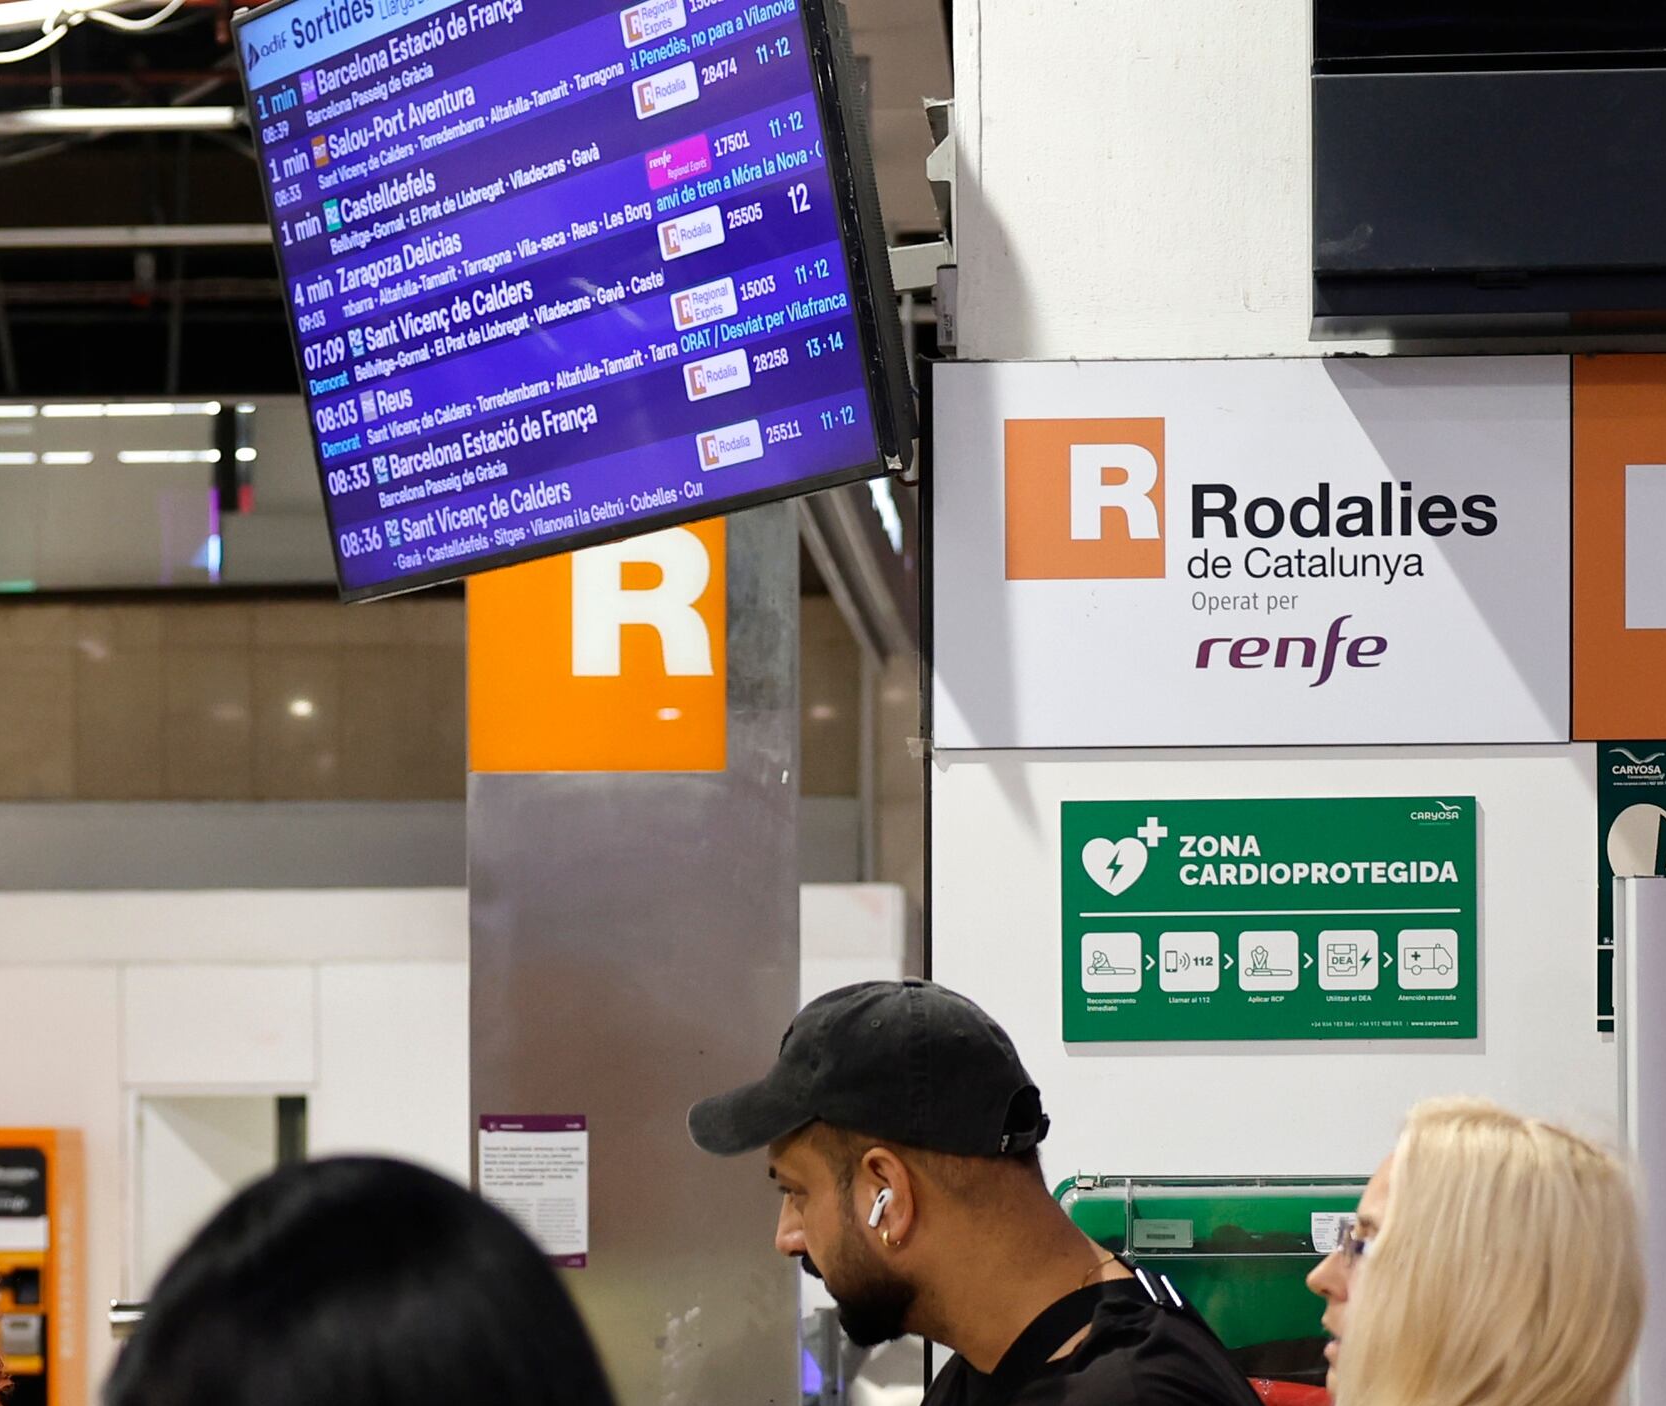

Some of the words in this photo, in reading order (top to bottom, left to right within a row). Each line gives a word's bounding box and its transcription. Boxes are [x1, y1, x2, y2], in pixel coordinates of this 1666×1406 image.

[291, 0, 374, 49] Sortides
[639, 36, 690, 68] Penedès,
[691, 31, 706, 48] no
[707, 20, 734, 46] para
[743, 0, 796, 27] Vilanova
[316, 49, 389, 95] Barcelona
[388, 17, 445, 65] Estació
[447, 12, 467, 40] de
[468, 0, 523, 32] França
[701, 57, 737, 85] 28474
[270, 84, 298, 114] min
[306, 98, 353, 127] Barcelona
[351, 81, 388, 108] Passeig
[388, 75, 402, 93] de
[401, 62, 434, 87] Gràcia
[328, 108, 407, 159] Salou-Port
[409, 86, 475, 129] Aventura
[714, 130, 750, 157] 17501
[269, 158, 281, 183] 1
[282, 148, 310, 178] min
[681, 184, 696, 204] de
[697, 179, 722, 198] tren
[731, 163, 763, 187] Móra
[762, 157, 776, 176] la
[776, 149, 808, 172] Nova
[324, 203, 341, 227] R2
[341, 168, 436, 223] Castelldefels
[787, 183, 811, 214] 12
[281, 221, 293, 246] 1
[294, 212, 322, 241] min
[727, 202, 763, 229] 25505
[336, 254, 403, 293] Zaragoza
[402, 231, 462, 270] Delicias
[294, 283, 305, 307] 4
[306, 275, 334, 304] min
[740, 275, 776, 301] 15003
[364, 320, 400, 351] Sant
[397, 308, 450, 340] Vicenç
[451, 296, 472, 323] de
[472, 280, 533, 316] Calders
[680, 328, 711, 353] ORAT
[720, 314, 765, 342] Desviat
[765, 310, 785, 333] per
[785, 293, 847, 322] Vilafranca
[304, 336, 345, 371] 07:09
[753, 348, 789, 373] 28258
[309, 370, 350, 396] Demorat
[316, 399, 358, 433] 08:03
[376, 389, 413, 415] Reus
[321, 433, 362, 458] Demorat
[388, 442, 463, 479] Barcelona
[462, 418, 519, 459] Estació
[521, 415, 542, 442] de
[542, 404, 598, 436] França
[766, 420, 802, 444] 25511
[328, 462, 370, 496] 08:33
[1070, 443, 1161, 540] R
[401, 513, 437, 542] Sant
[435, 504, 488, 533] Vicenç
[489, 493, 510, 520] de
[510, 481, 571, 514] Calders
[1191, 481, 1499, 539] Rodalies
[340, 526, 382, 558] 08:36
[1187, 548, 1232, 580] de
[1243, 546, 1425, 585] Catalunya
[571, 526, 714, 676] R
[1191, 591, 1260, 615] Operat
[1266, 593, 1299, 615] per
[1194, 614, 1388, 688] renfe
[1611, 764, 1662, 775] CARYOSA
[1410, 810, 1460, 821] CARYOSA
[1179, 835, 1261, 858] ZONA
[1179, 860, 1459, 886] CARDIOPROTEGIDA
[1192, 956, 1214, 967] 112
[1331, 955, 1354, 966] DEA
[1168, 996, 1190, 1004] Llamar
[1199, 996, 1211, 1004] 112
[1247, 995, 1270, 1004] Aplicar
[1271, 995, 1285, 1003] RCP
[1358, 994, 1372, 1002] DEA
[1398, 993, 1426, 1002] Atención
[1427, 993, 1457, 1002] avanzada
